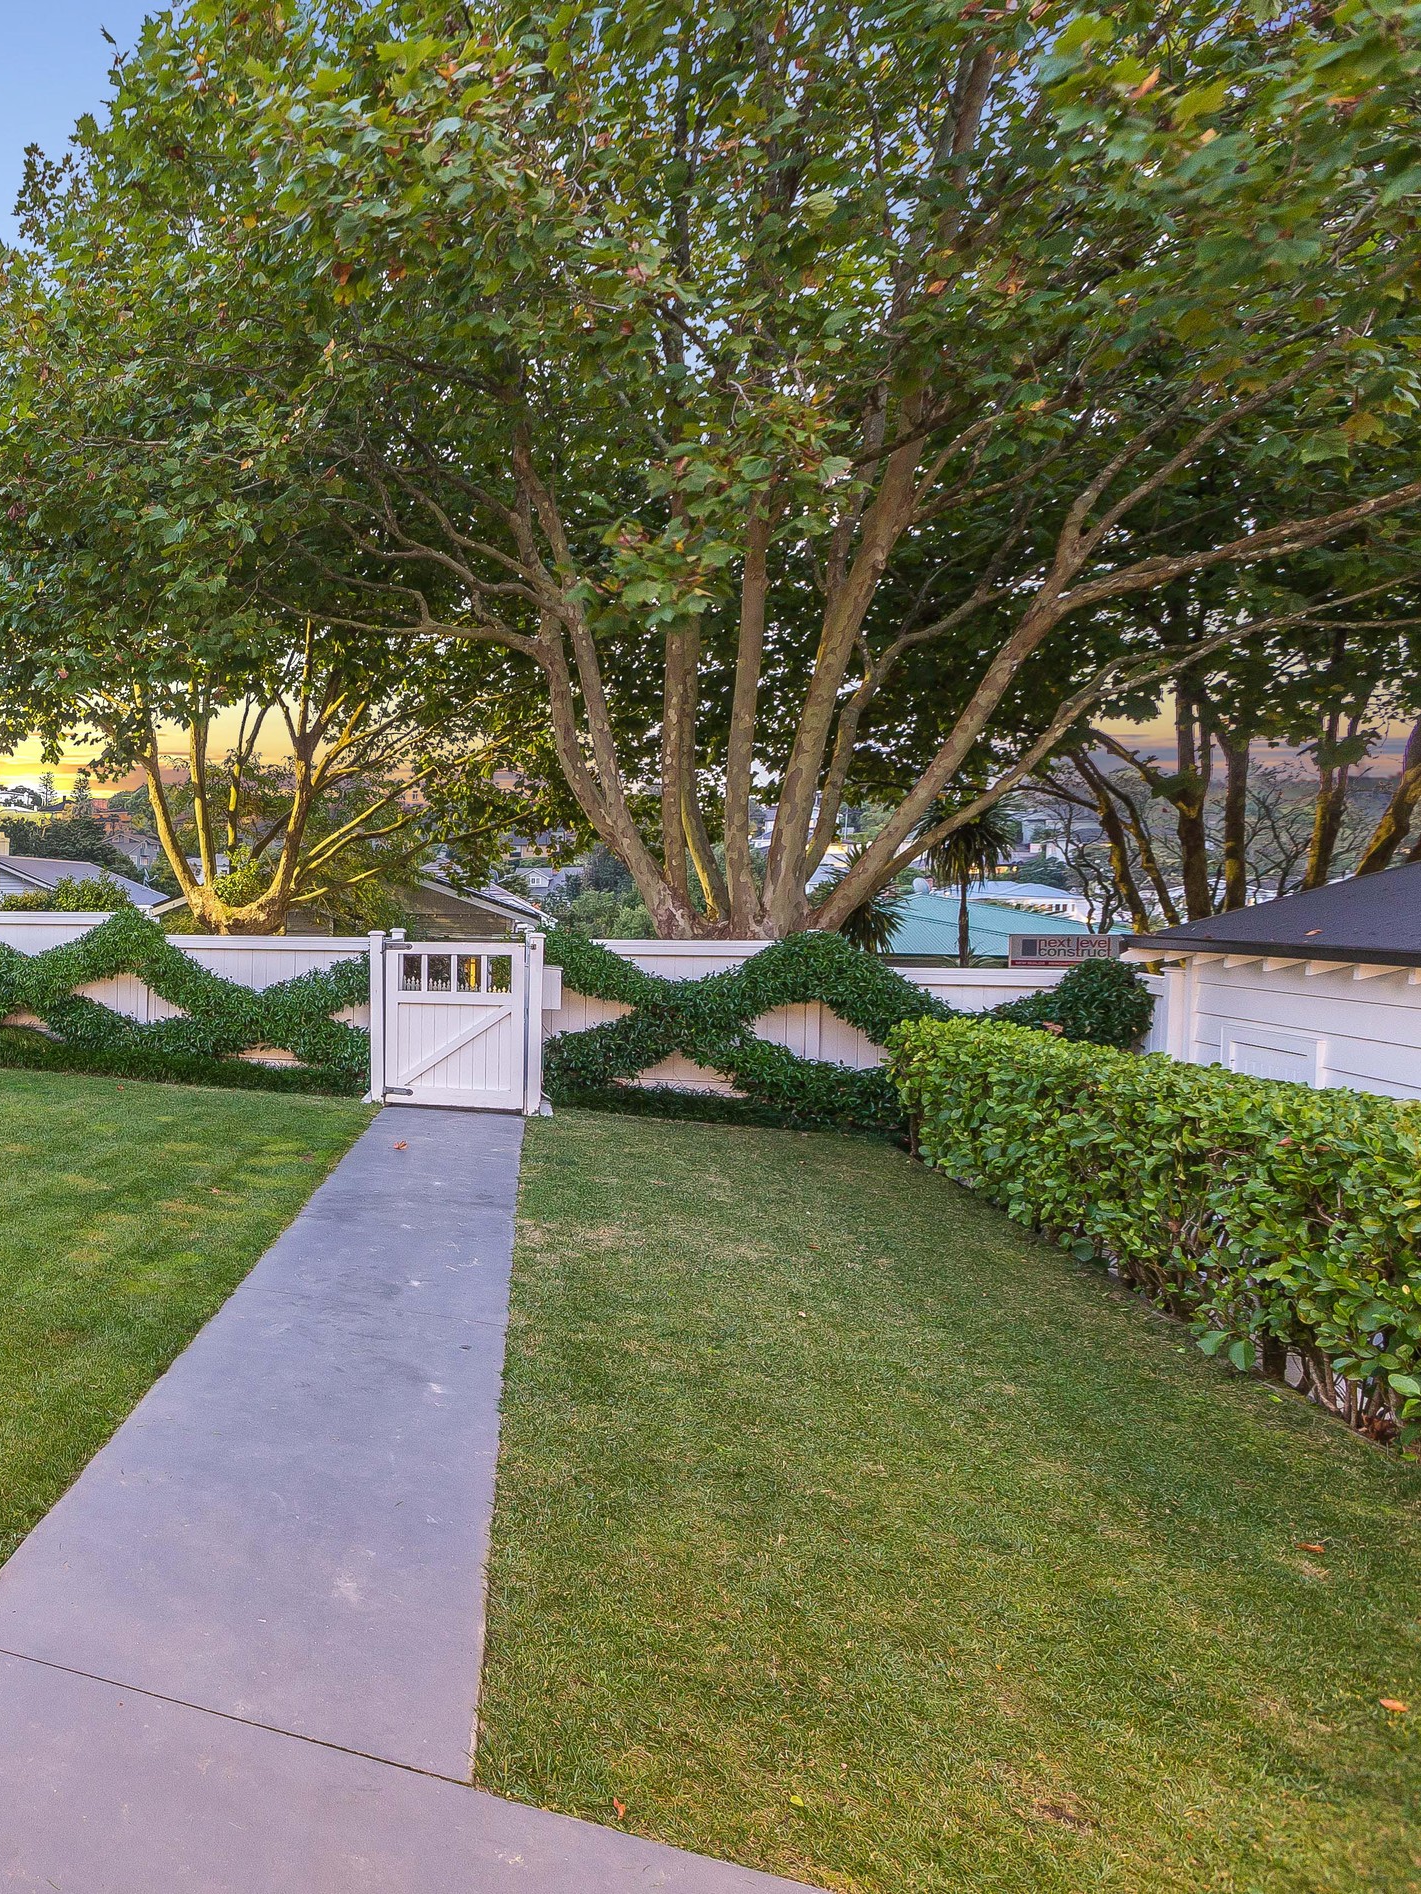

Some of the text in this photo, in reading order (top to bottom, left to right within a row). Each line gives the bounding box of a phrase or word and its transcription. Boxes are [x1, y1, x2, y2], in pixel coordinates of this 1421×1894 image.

[1039, 937, 1111, 949] next level
[1039, 947, 1111, 957] construct
